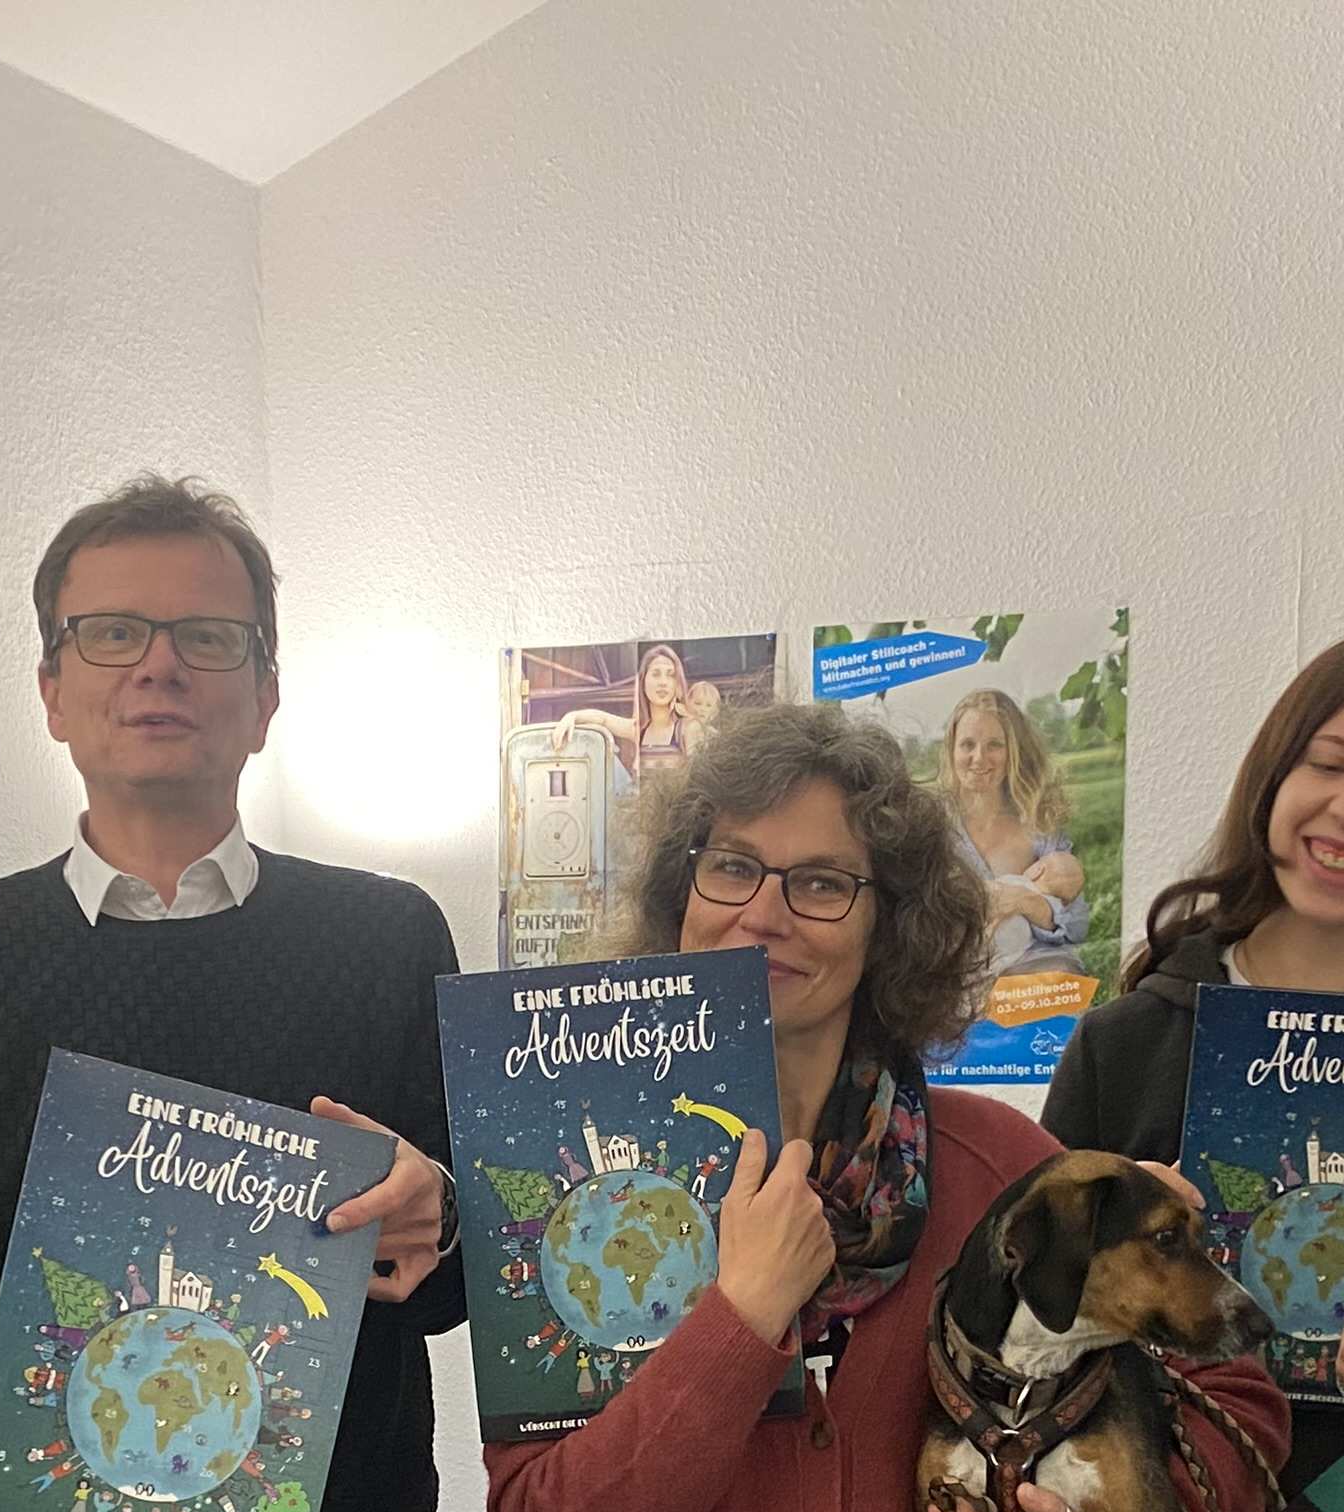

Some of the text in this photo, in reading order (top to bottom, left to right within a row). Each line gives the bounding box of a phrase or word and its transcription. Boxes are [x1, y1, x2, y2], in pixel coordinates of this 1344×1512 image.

[820, 653, 868, 671] Digitaler
[871, 641, 927, 660] Stillcoach
[822, 646, 966, 683] Mitmachen und gewinnen!
[516, 913, 596, 930] ENTSPANNT
[993, 980, 1080, 1001] Weltstillwoche
[505, 999, 716, 1081] Adventszeit
[941, 1064, 959, 1076] für
[961, 1064, 1032, 1078] nachhaltige
[97, 1120, 329, 1234] Adventszeit
[226, 1237, 237, 1249] 2
[308, 1357, 321, 1369] 23
